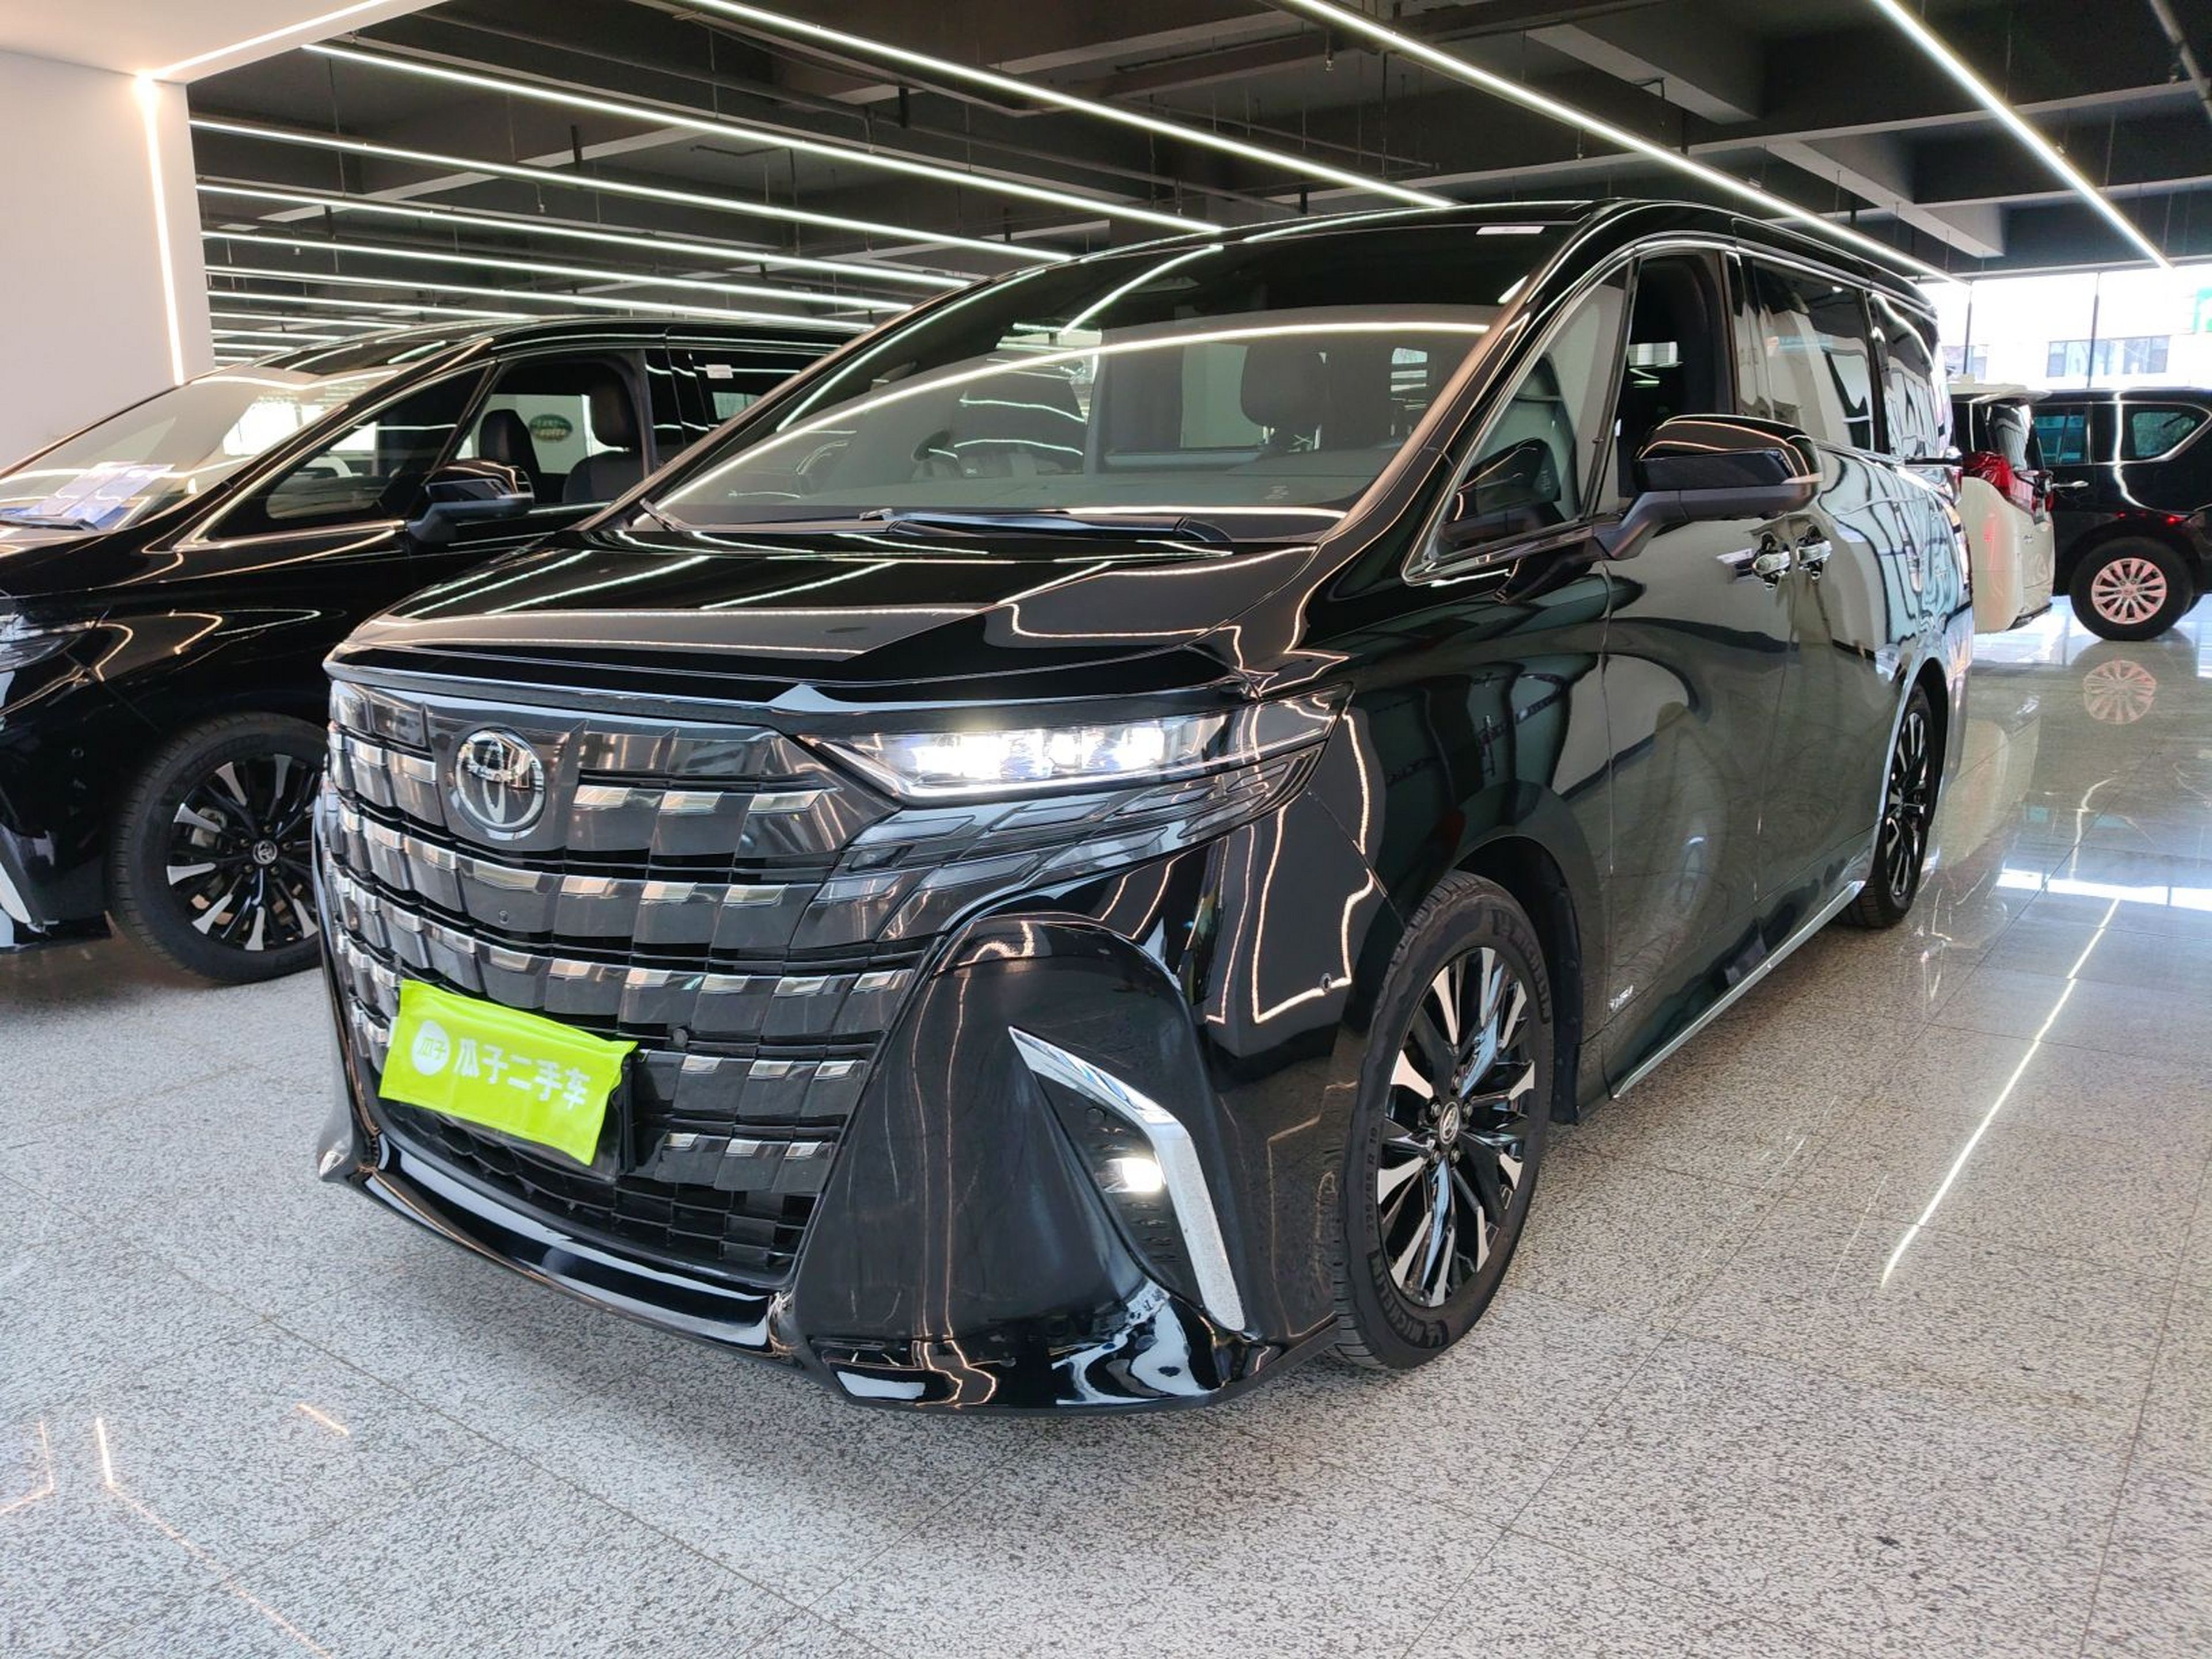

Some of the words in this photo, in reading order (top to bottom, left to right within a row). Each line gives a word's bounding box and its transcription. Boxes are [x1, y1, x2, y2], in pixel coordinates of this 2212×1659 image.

[418, 1037, 445, 1060] 瓜子
[454, 1039, 590, 1109] 瓜子二手车
[1370, 1255, 1425, 1343] MICHELIN
